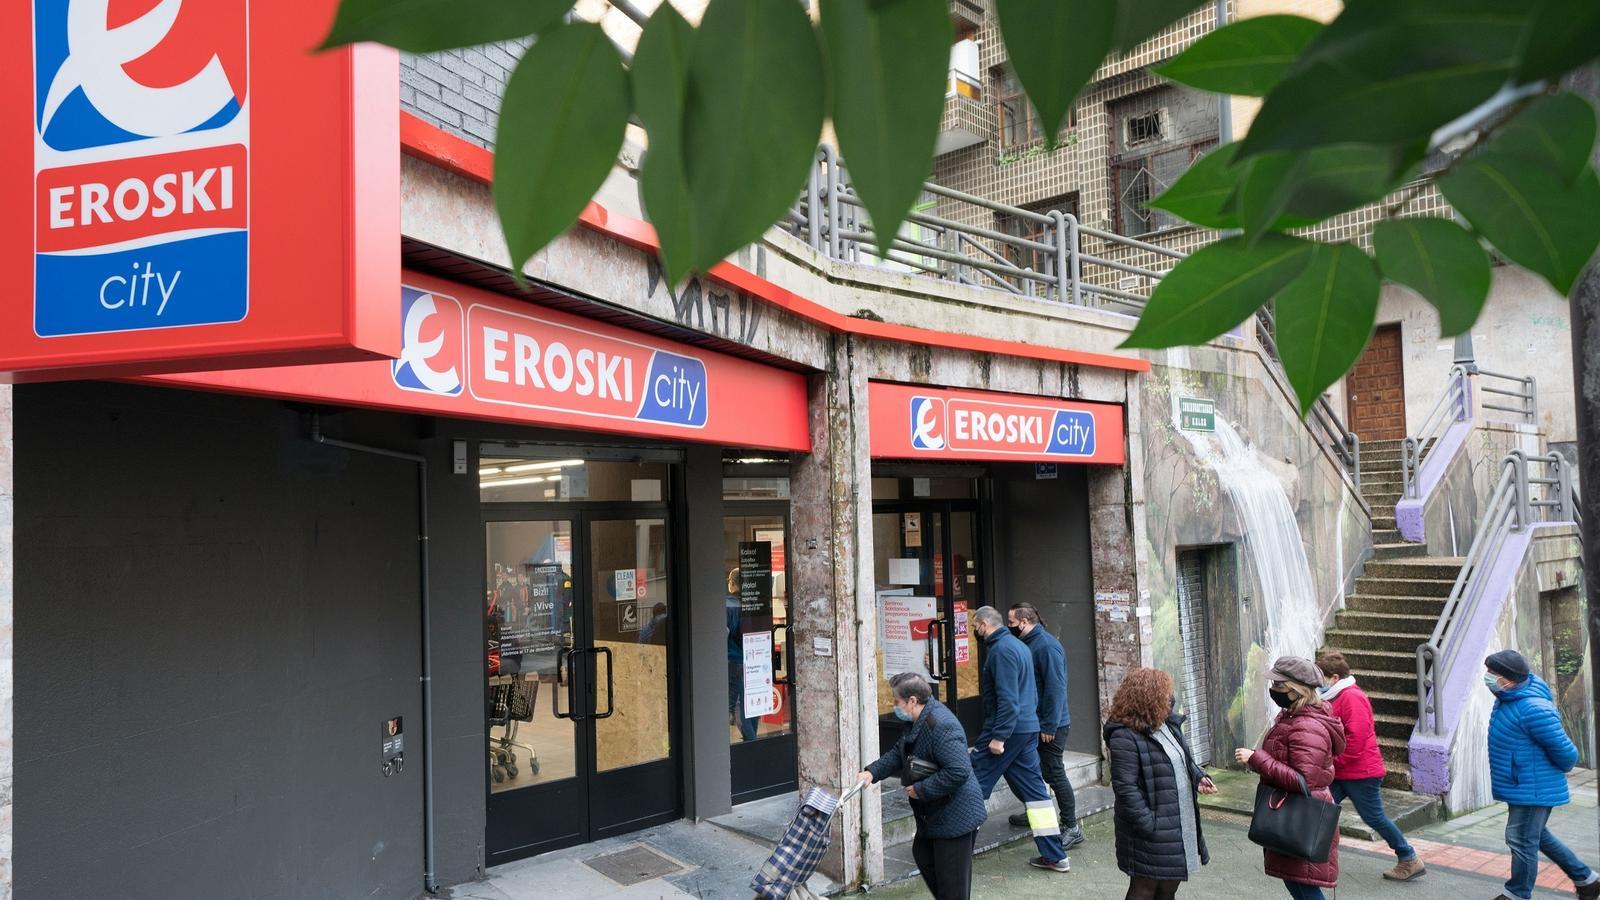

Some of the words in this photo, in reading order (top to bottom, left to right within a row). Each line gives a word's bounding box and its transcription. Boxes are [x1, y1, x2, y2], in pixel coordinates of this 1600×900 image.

[48, 165, 234, 230] EROSKI
[99, 261, 182, 316] city
[482, 328, 634, 403] EROSKI
[654, 369, 701, 420] city
[954, 410, 1043, 444] EROSKI
[1057, 418, 1090, 452] city
[616, 571, 634, 581] CLEAN
[533, 602, 554, 612] ¡Vive
